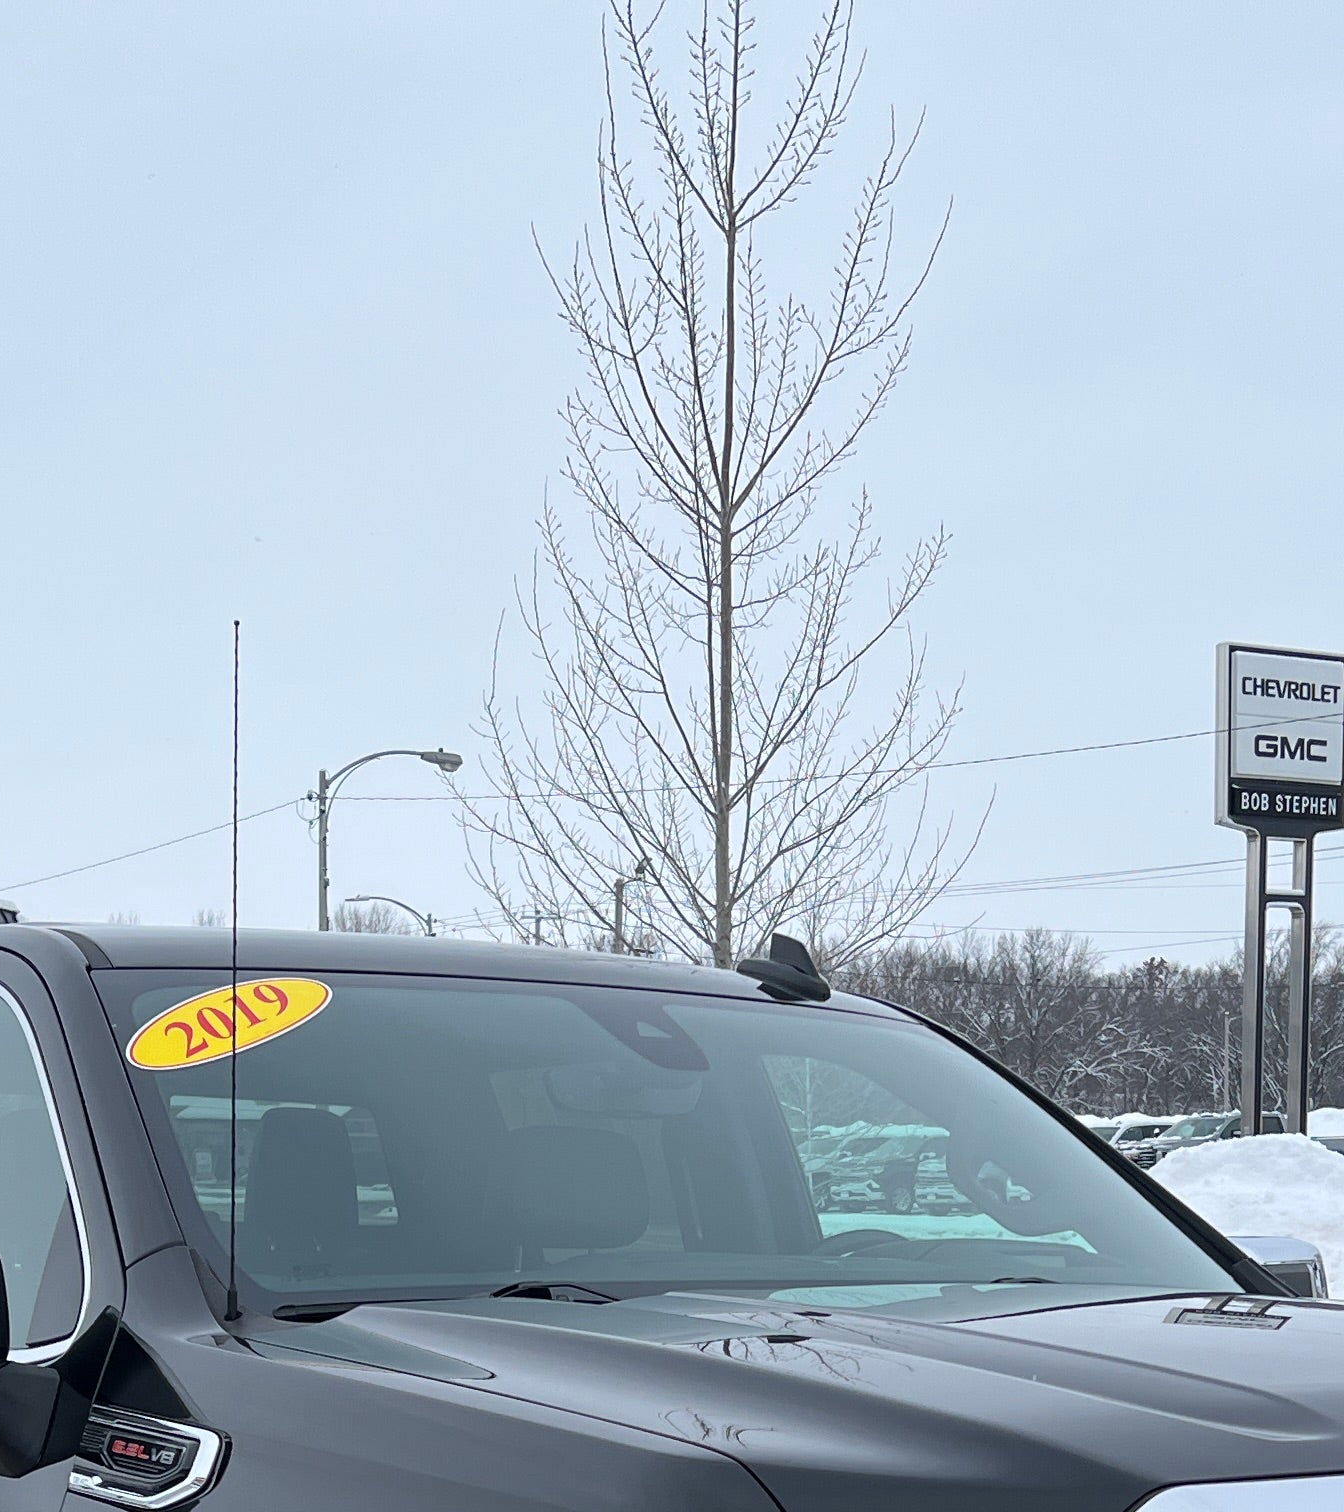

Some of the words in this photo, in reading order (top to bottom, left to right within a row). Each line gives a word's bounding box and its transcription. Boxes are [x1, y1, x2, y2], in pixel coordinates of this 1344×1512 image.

[1241, 676, 1341, 704] CHEVROLET
[1254, 734, 1328, 762] GMC
[1240, 791, 1269, 812] BOB
[1275, 793, 1337, 816] STEPHEN
[164, 983, 289, 1058] 2019
[151, 1447, 177, 1465] V8
